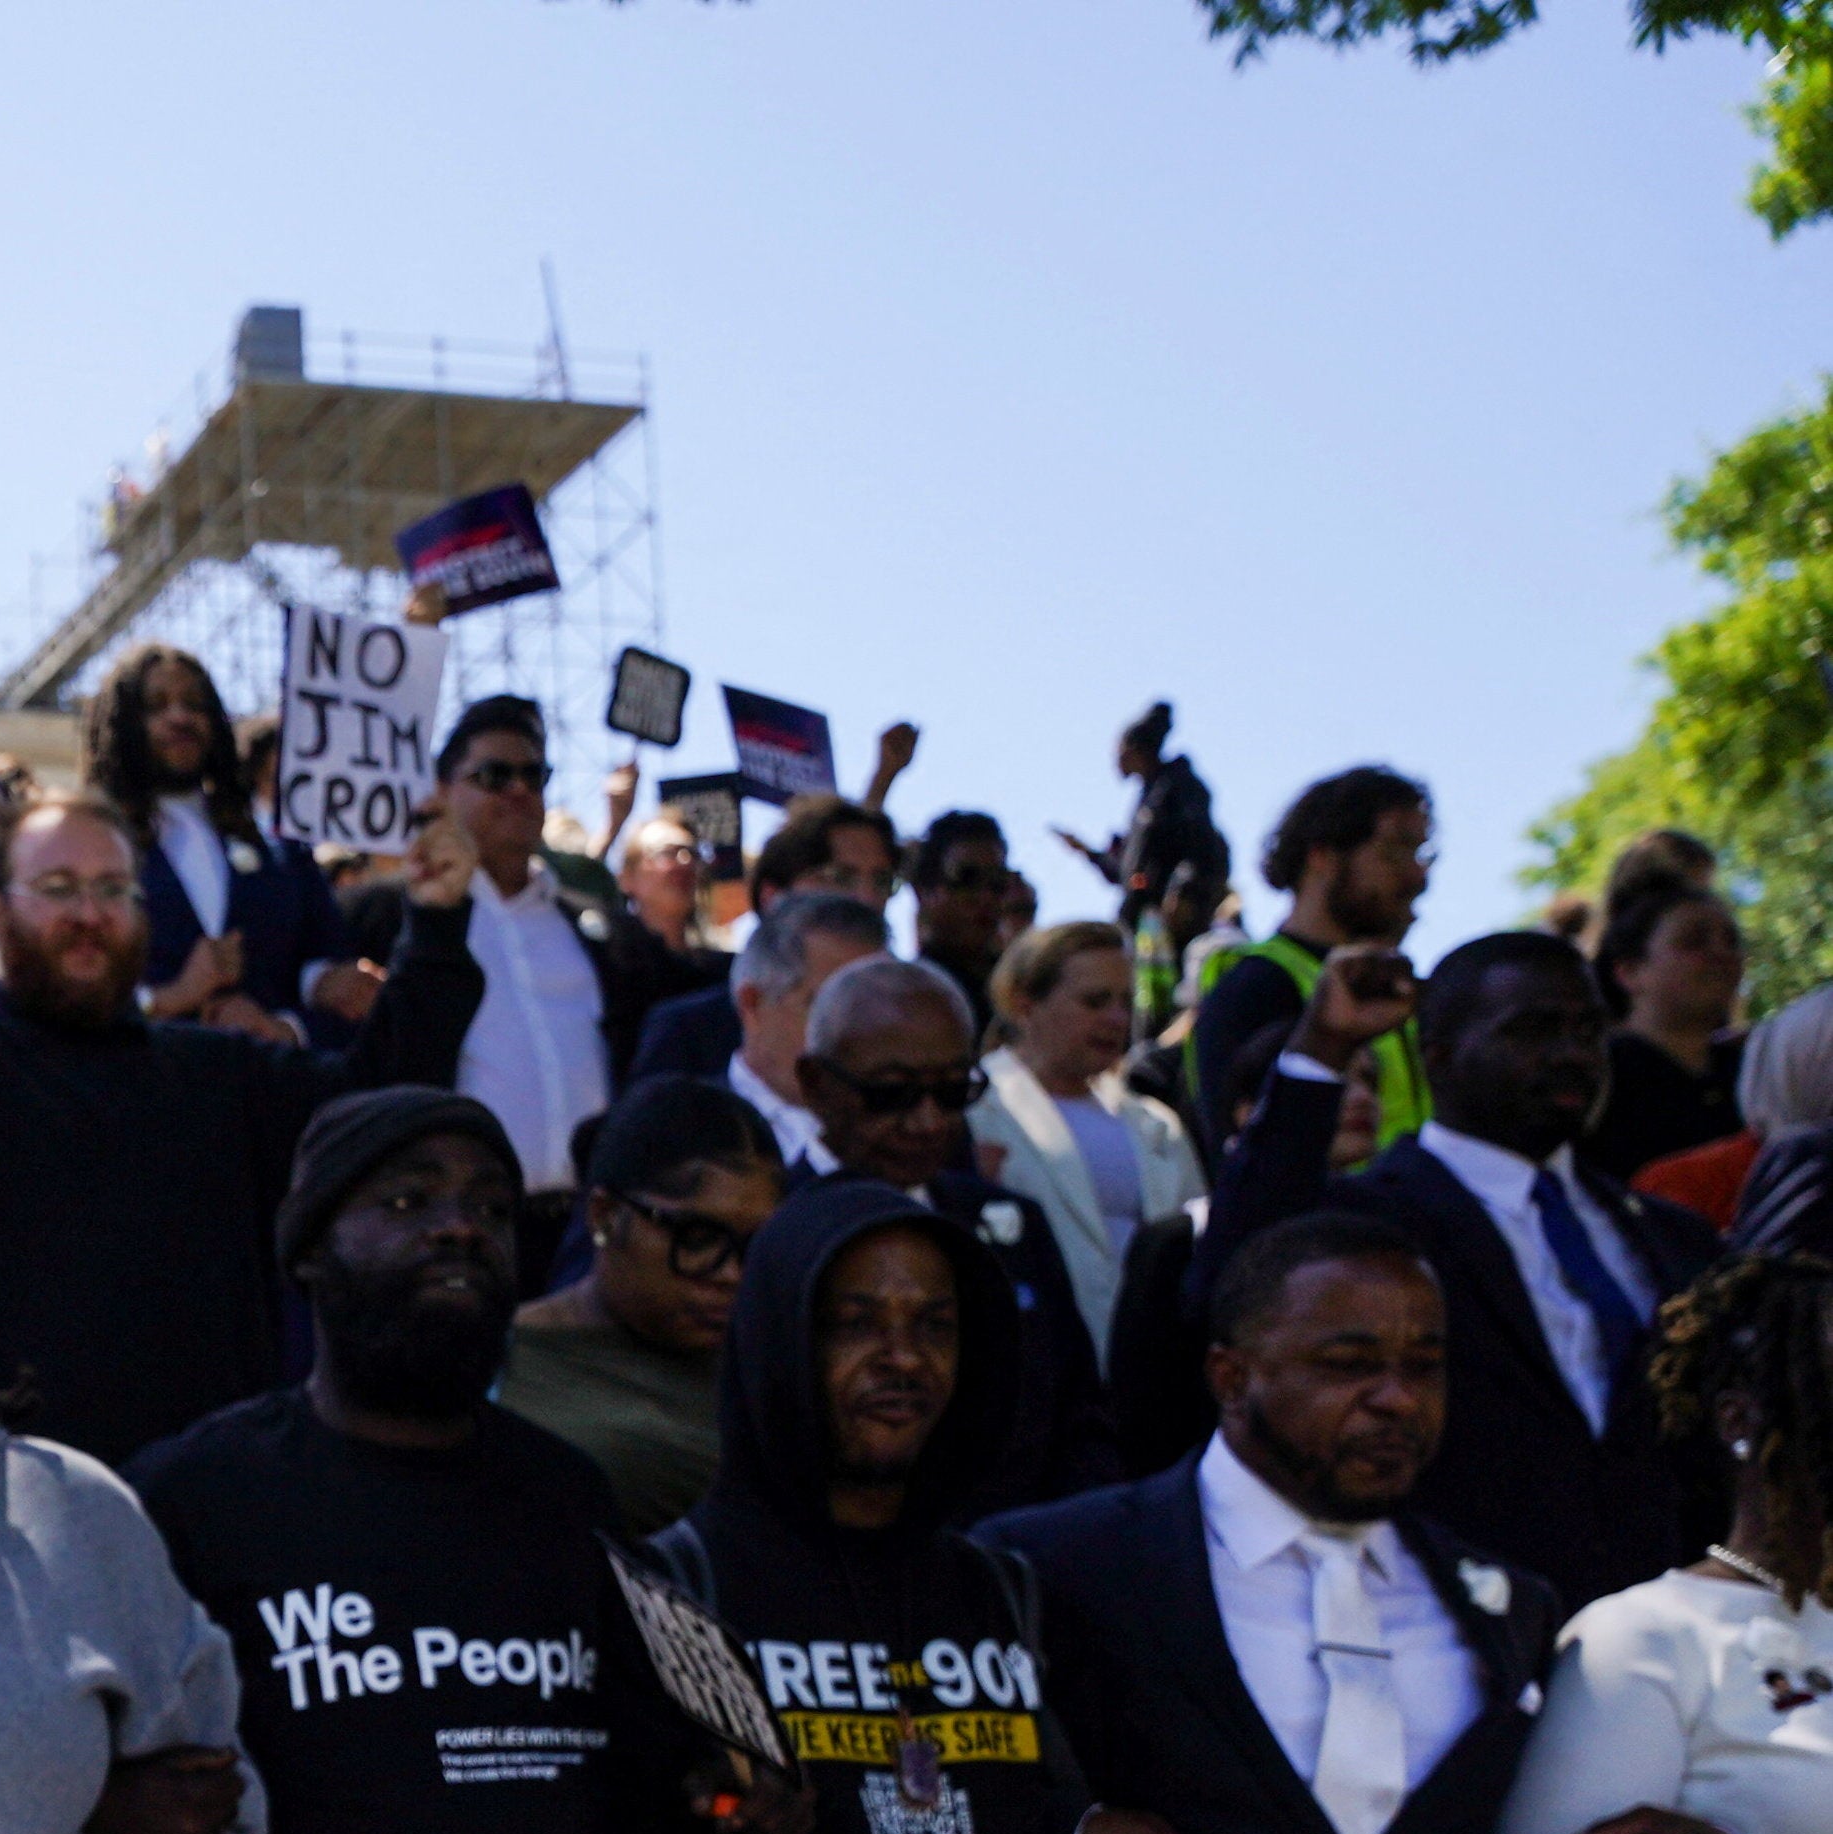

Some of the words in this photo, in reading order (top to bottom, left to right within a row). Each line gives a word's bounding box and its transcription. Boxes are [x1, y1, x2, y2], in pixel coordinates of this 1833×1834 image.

[308, 611, 407, 690] NO
[294, 687, 426, 776] JIM
[257, 1582, 376, 1652] We
[271, 1642, 403, 1711] The
[413, 1627, 599, 1701] People
[743, 1639, 893, 1711] REE
[826, 1718, 898, 1757] KEEP
[952, 1717, 1020, 1757] SAFE
